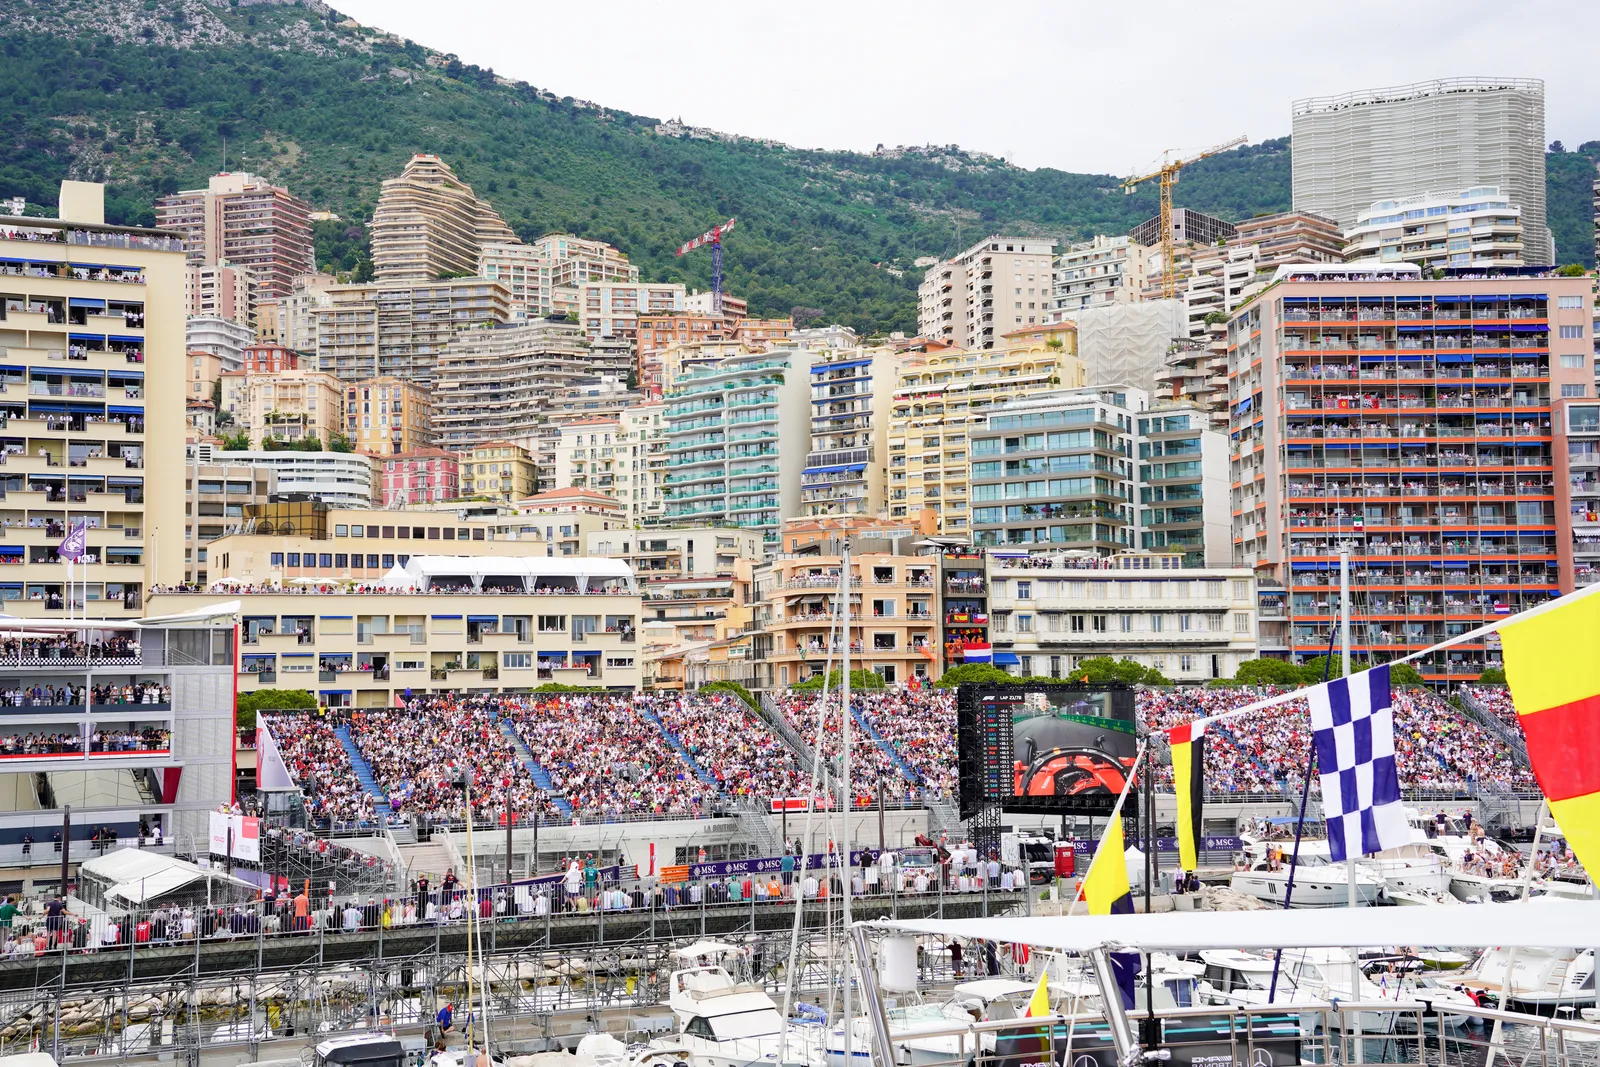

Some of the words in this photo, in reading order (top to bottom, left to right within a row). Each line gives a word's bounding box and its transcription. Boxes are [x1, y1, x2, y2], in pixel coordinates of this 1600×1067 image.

[732, 863, 748, 872] MSC
[764, 860, 780, 868] MSC
[701, 865, 716, 874] MSC
